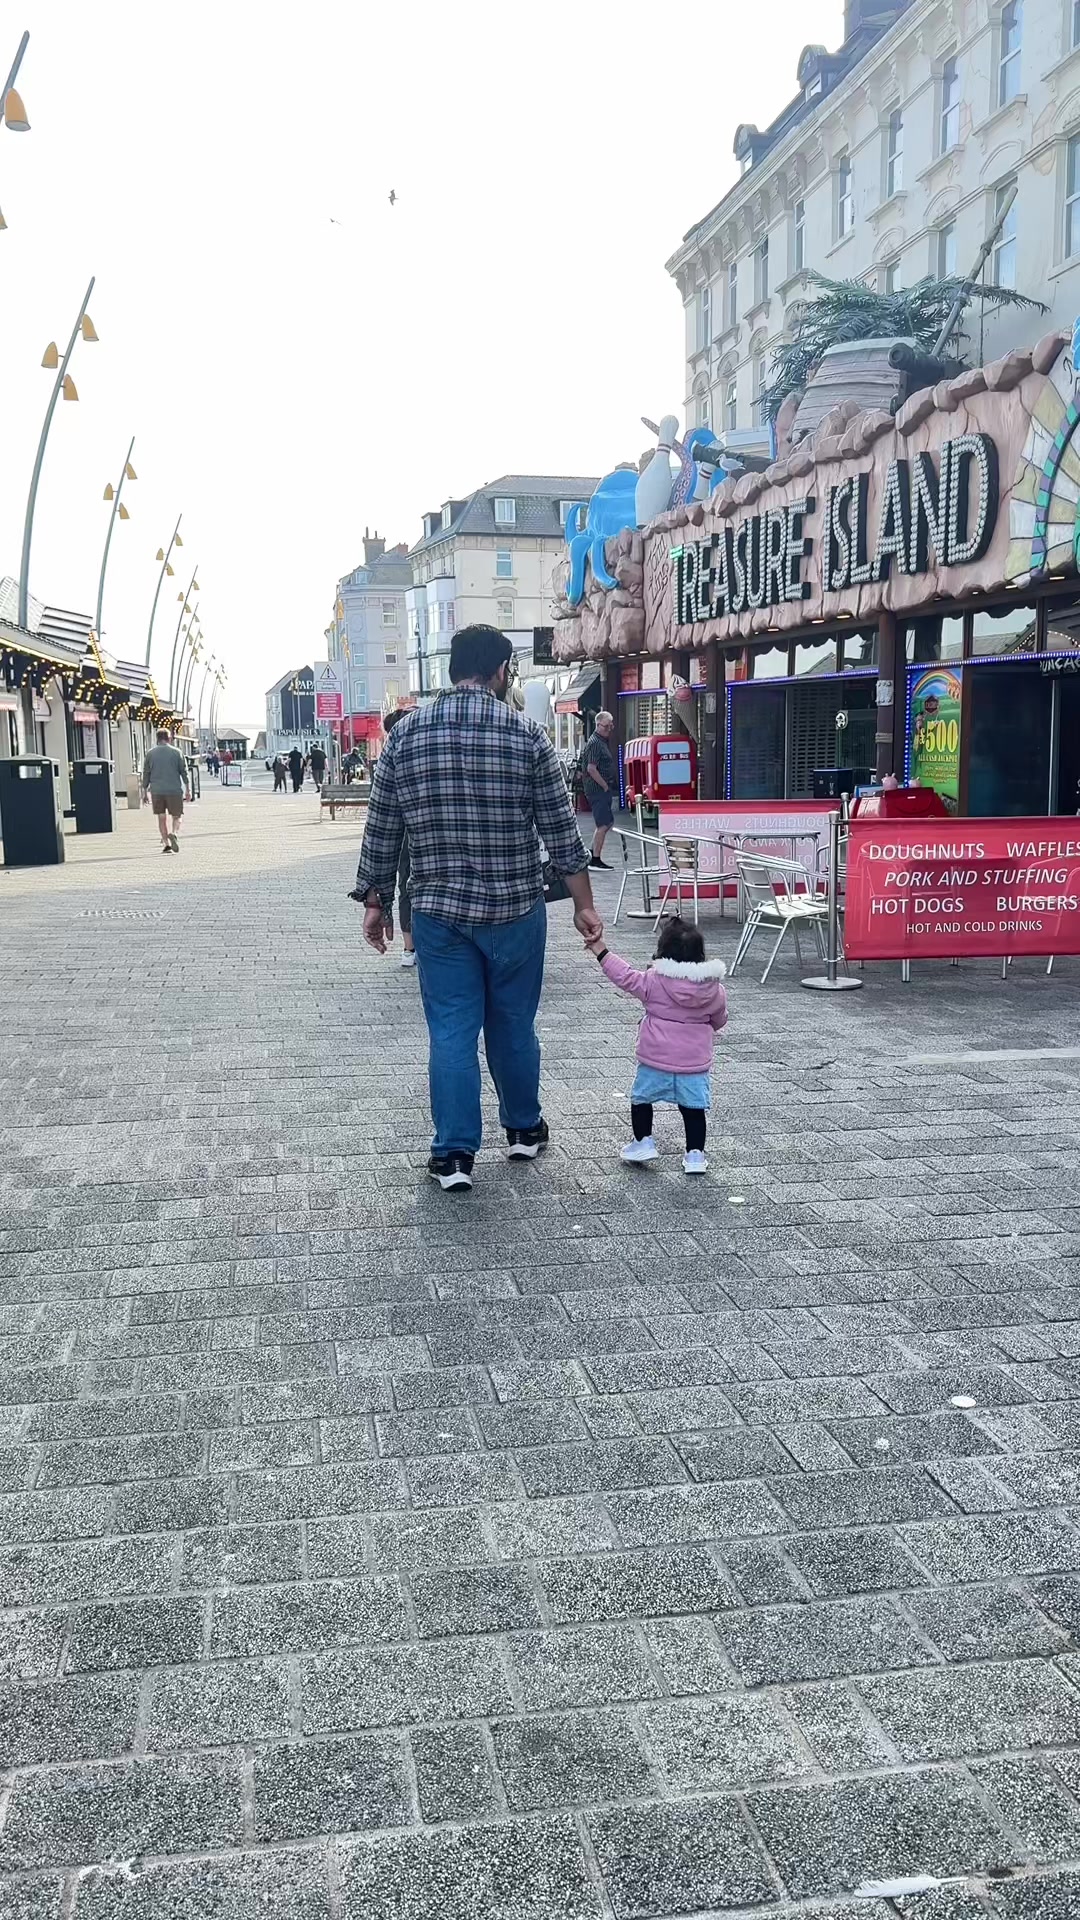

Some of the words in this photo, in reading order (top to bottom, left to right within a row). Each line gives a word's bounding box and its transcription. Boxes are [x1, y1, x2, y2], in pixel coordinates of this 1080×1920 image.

[670, 497, 815, 625] TREASURE
[823, 433, 999, 592] ISLAND
[919, 719, 958, 753] £500
[869, 843, 985, 860] DOUGHNUTS
[1007, 841, 1080, 858] WAFFLES
[884, 871, 935, 887] PORK
[937, 870, 978, 886] AND
[982, 868, 1068, 885] STUFFING
[872, 898, 909, 914] HOT
[914, 897, 964, 913] DOGS
[997, 895, 1078, 911] BURGERS
[906, 923, 931, 934] HOT
[935, 922, 960, 933] AND
[964, 921, 995, 932] COLD
[999, 920, 1043, 932] DRINKS
